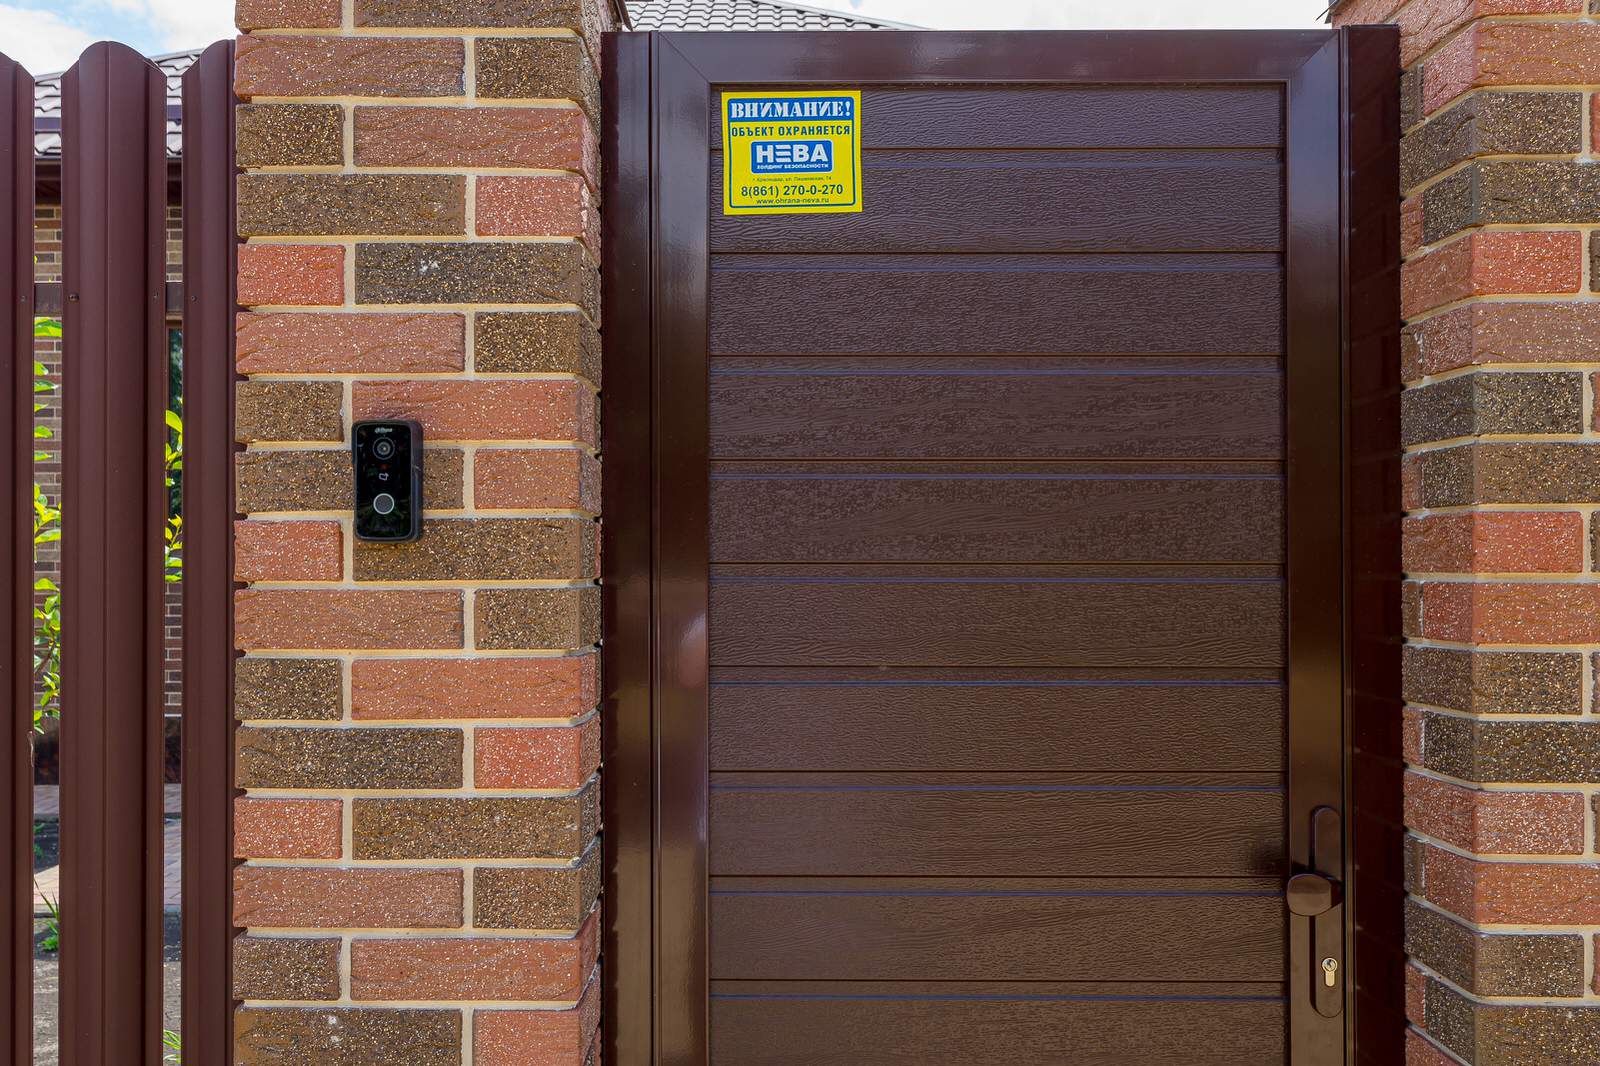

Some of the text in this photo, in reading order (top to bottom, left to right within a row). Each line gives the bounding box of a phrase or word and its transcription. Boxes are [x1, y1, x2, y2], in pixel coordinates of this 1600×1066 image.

[731, 101, 851, 118] ВНИМАНИЕ!
[731, 125, 850, 137] ОБЪЕКТ ОХРАНЯЕТСЯ
[755, 144, 828, 163] НЕВА
[741, 184, 844, 198] 8(861) 270-0-270
[756, 196, 830, 205] www.ohrana-neva.ru
